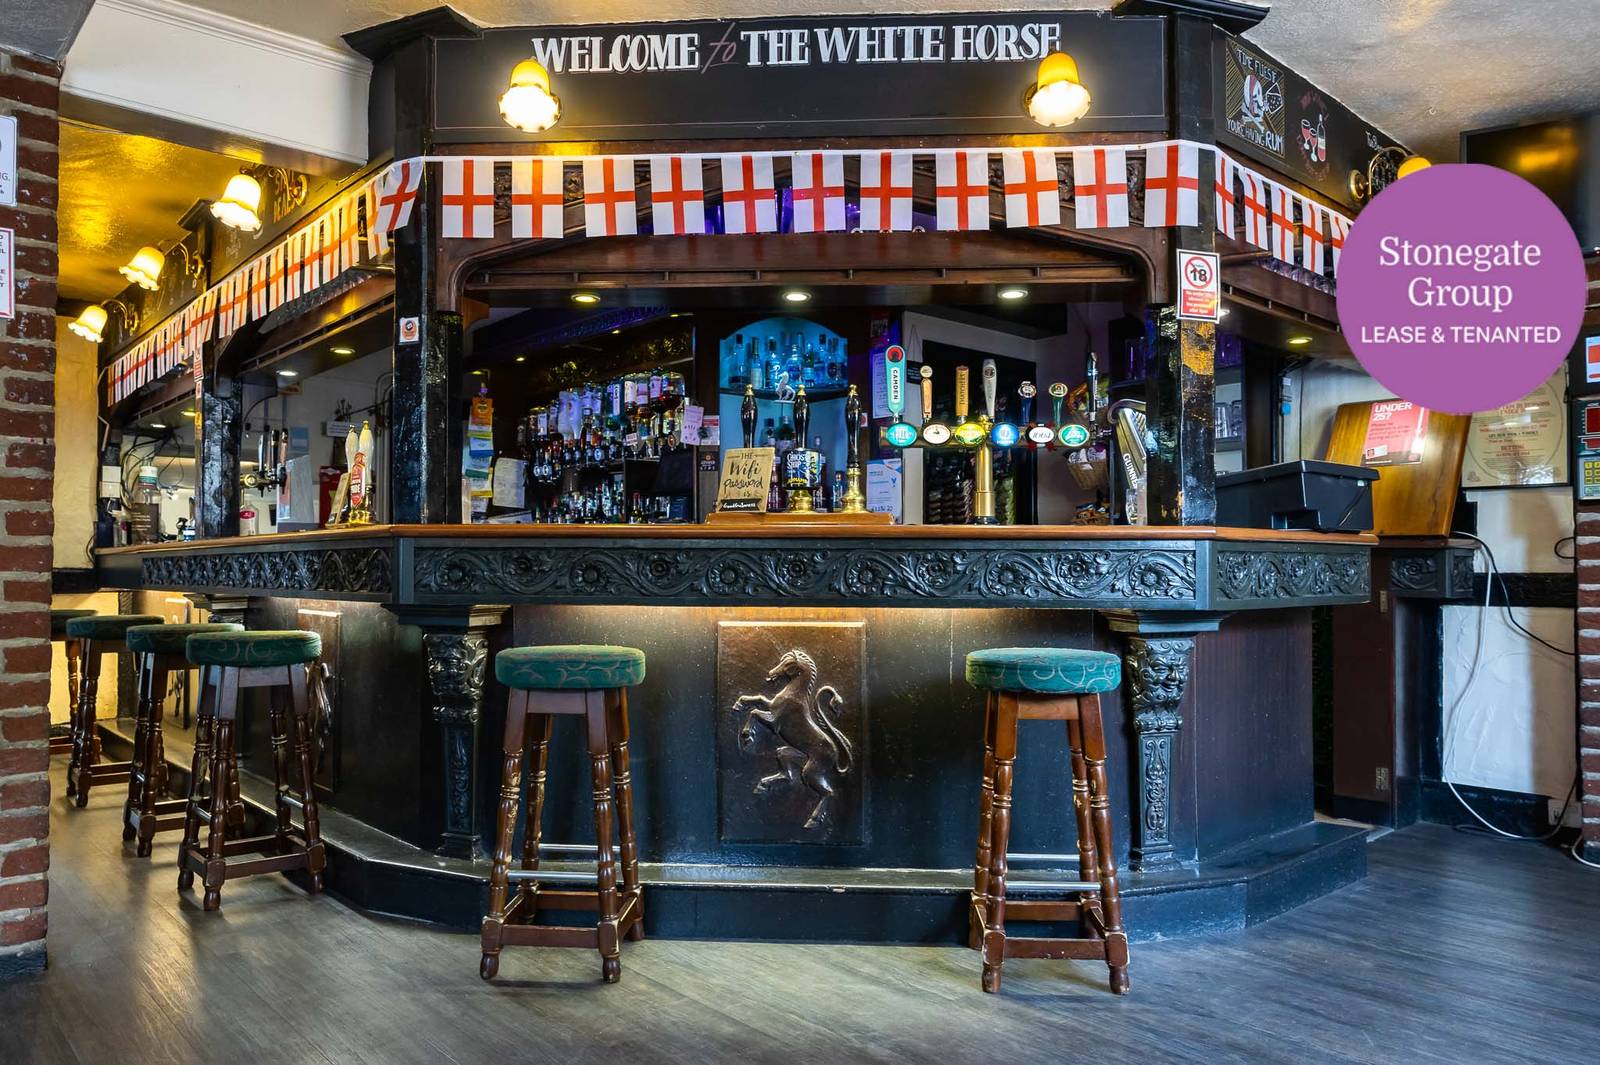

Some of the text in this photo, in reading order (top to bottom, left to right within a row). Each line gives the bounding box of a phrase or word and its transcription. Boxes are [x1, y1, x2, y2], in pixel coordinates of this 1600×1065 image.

[531, 21, 1061, 74] WELCOME to THE WHITE HORSE
[1190, 268, 1207, 282] 18
[892, 368, 900, 400] CAMDEN
[1375, 402, 1413, 413] UNDER
[729, 460, 761, 478] Wifi
[724, 477, 764, 495] password
